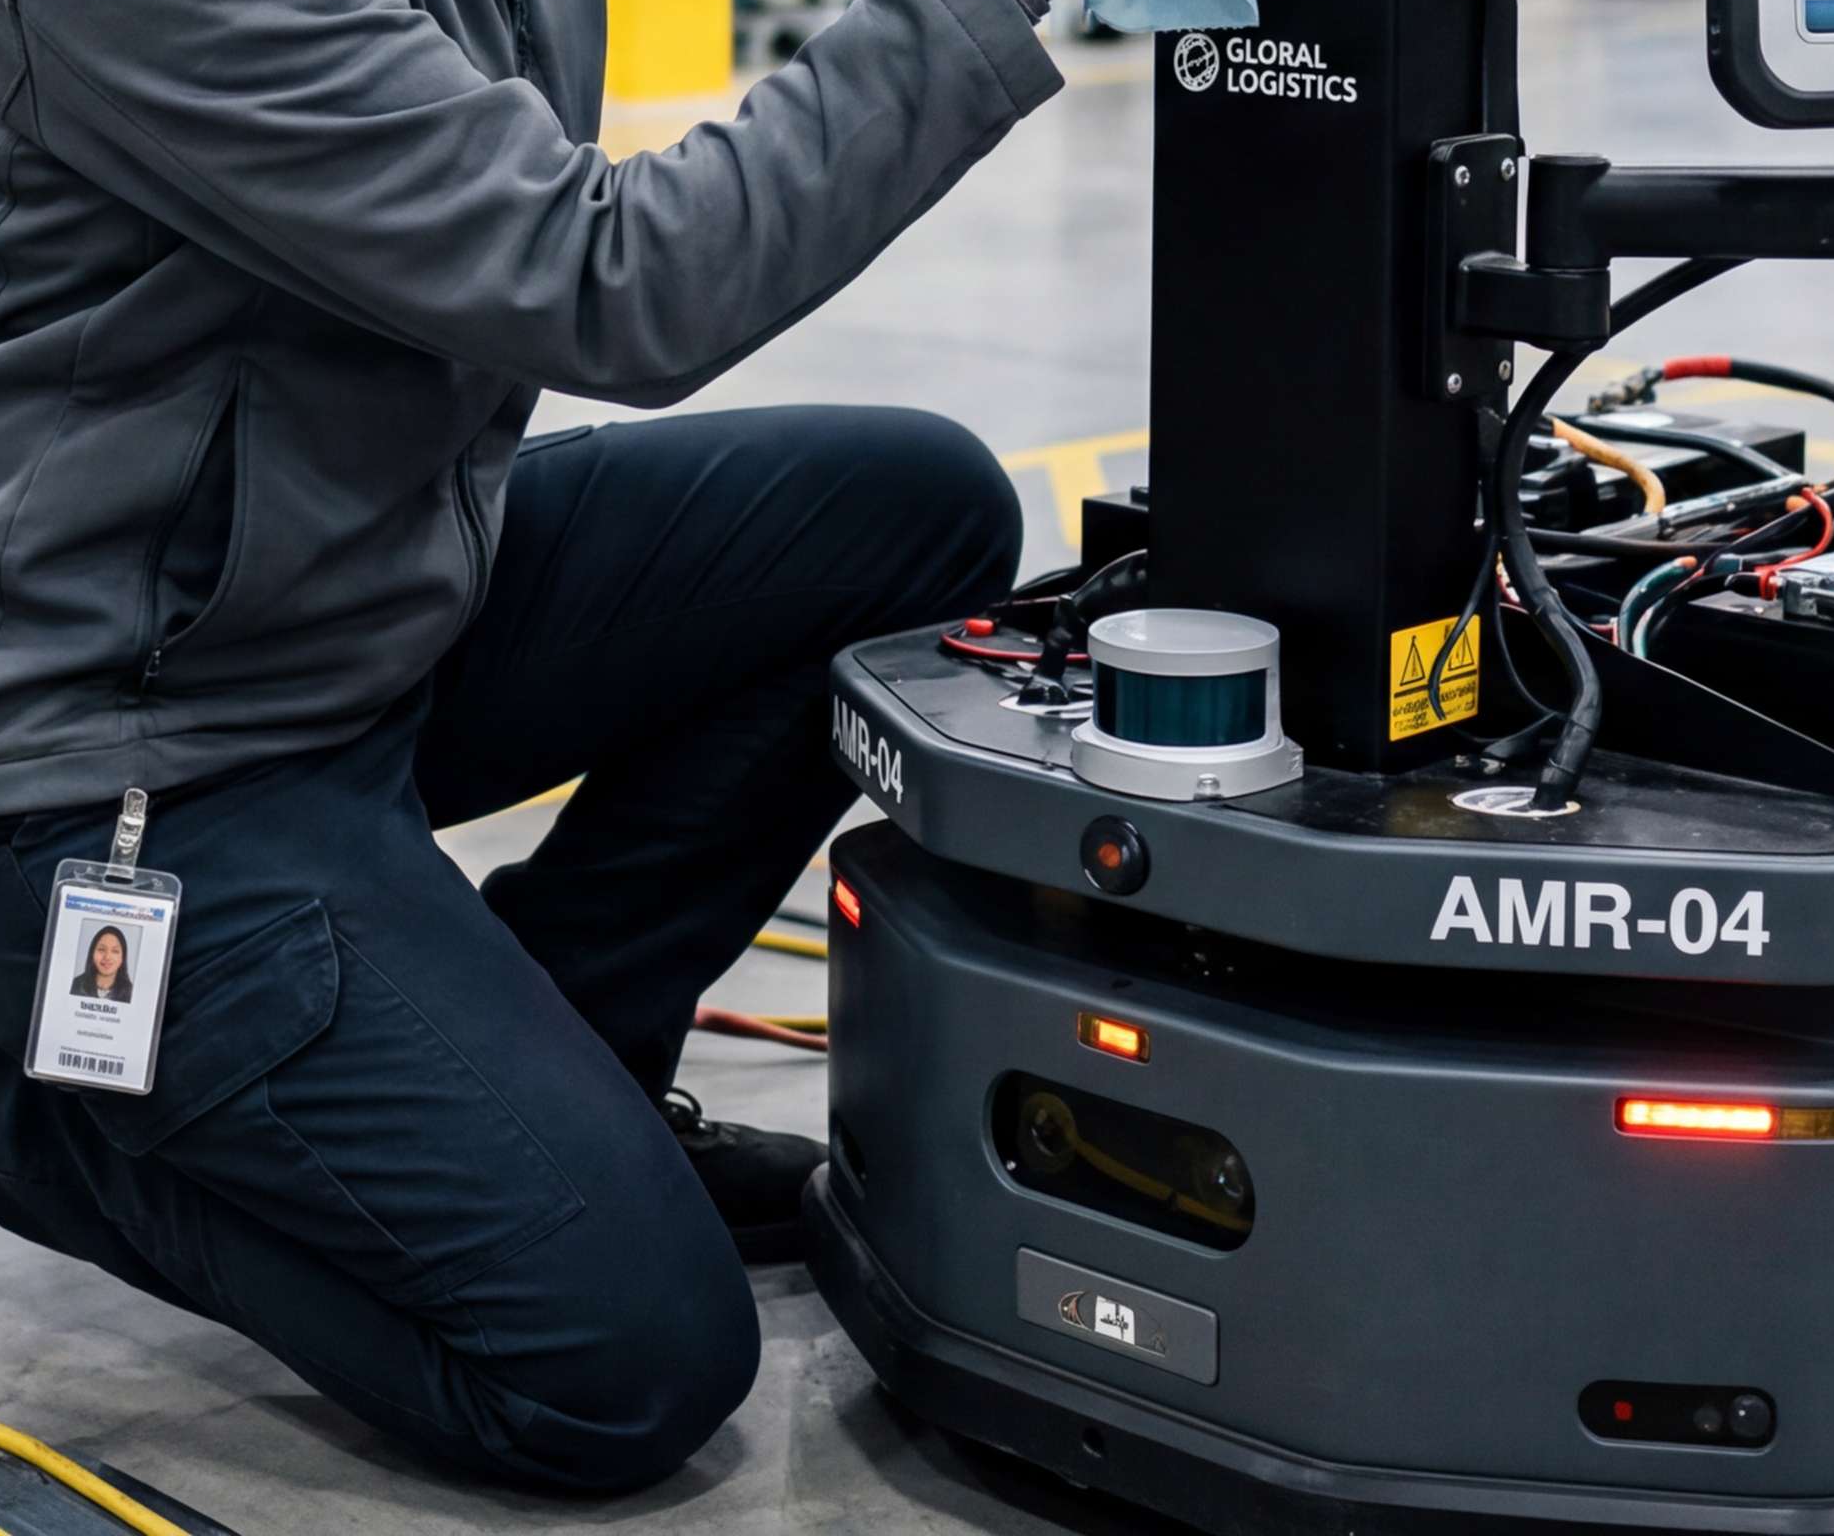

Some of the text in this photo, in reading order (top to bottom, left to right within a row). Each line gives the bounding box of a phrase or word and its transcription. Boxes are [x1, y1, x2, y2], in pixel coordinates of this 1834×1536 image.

[1227, 68, 1358, 103] LOGISTICS
[832, 694, 904, 805] AMR-04
[1430, 875, 1770, 957] AMR-04
